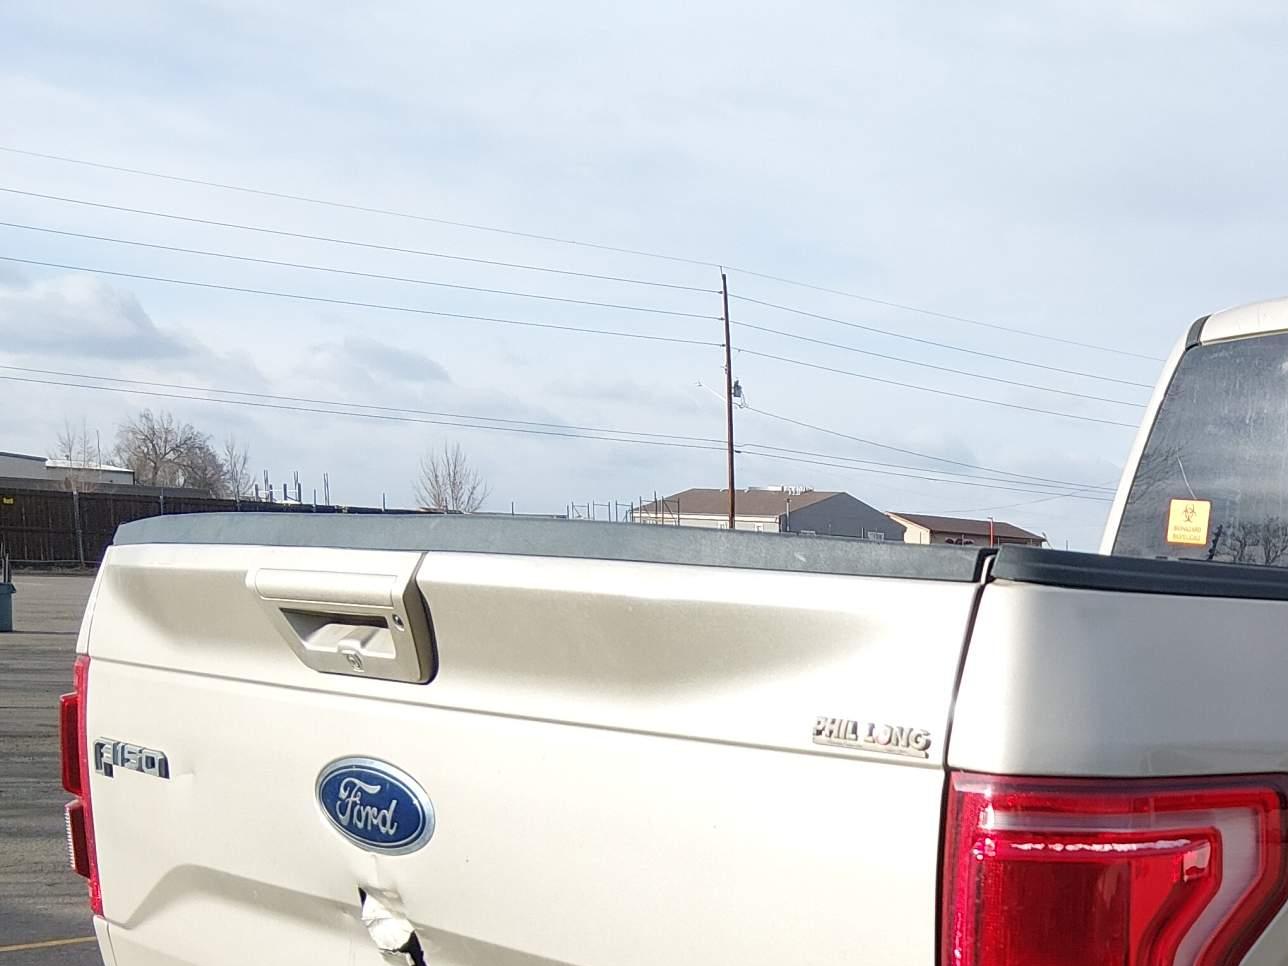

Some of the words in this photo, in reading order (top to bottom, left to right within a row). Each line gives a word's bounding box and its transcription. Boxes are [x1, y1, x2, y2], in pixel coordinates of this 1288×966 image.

[813, 716, 858, 741] PHIL
[863, 722, 932, 751] LONG
[335, 777, 398, 835] Ford
